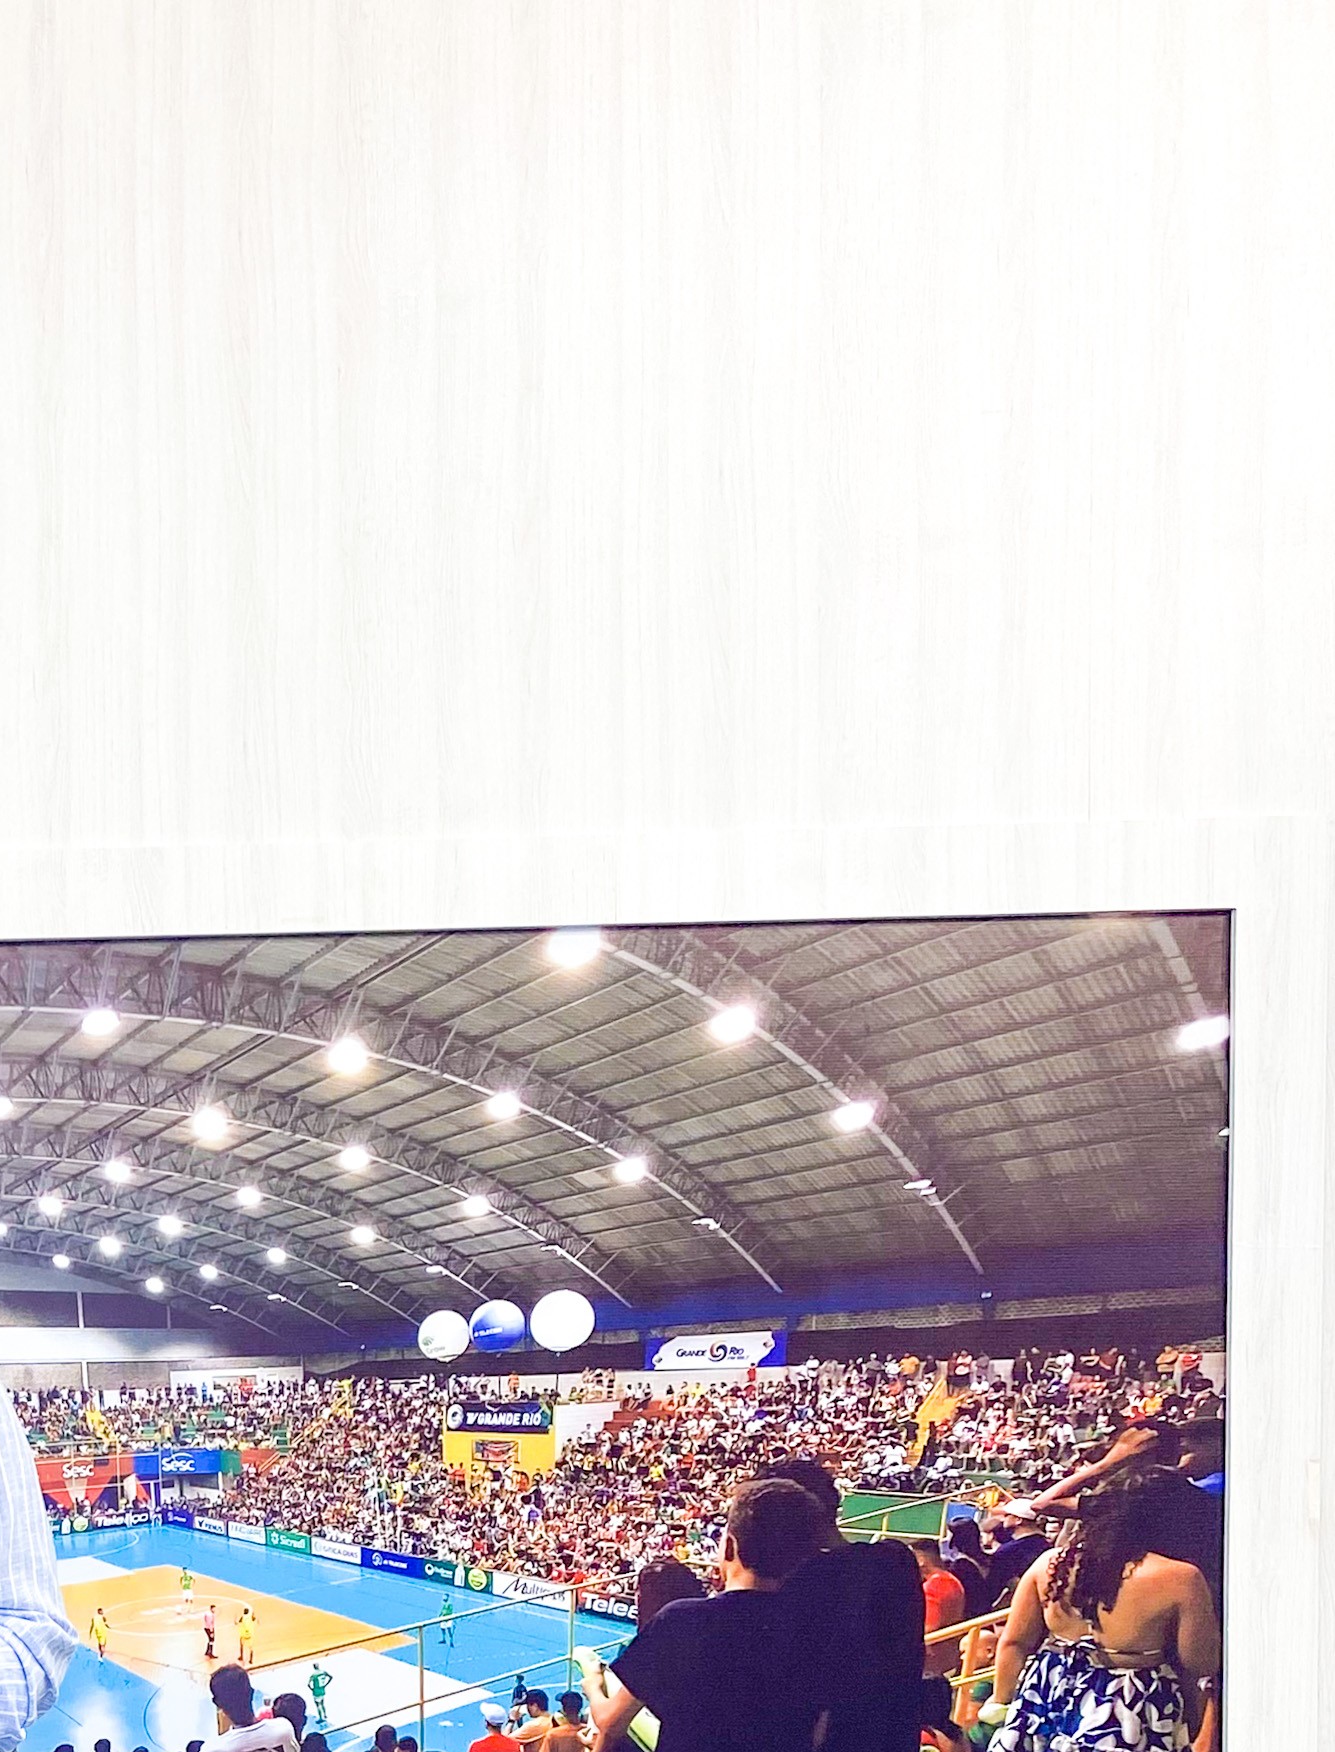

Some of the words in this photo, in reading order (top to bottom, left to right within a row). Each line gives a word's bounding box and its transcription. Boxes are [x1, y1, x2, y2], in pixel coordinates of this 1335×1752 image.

[478, 1411, 520, 1426] GRANDE
[521, 1411, 543, 1426] RIO
[62, 1463, 95, 1479] Sesc
[162, 1457, 195, 1472] Sesc
